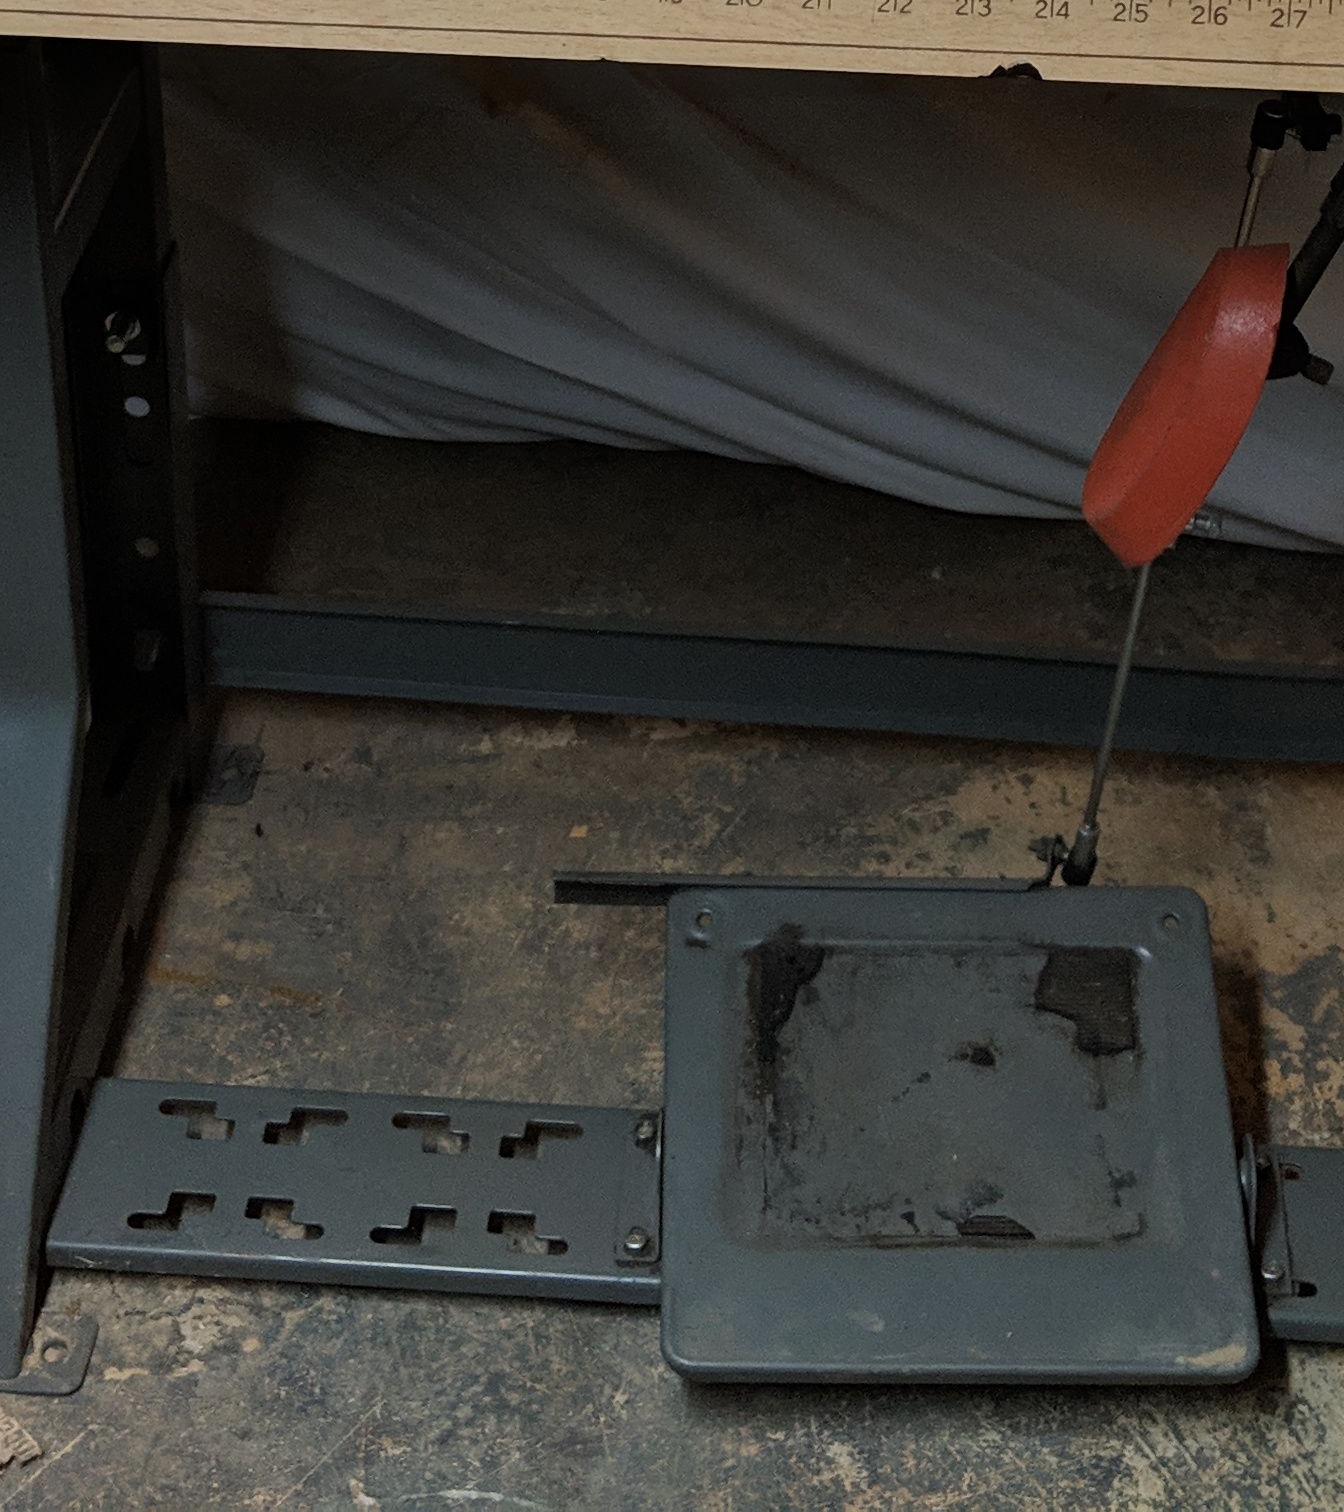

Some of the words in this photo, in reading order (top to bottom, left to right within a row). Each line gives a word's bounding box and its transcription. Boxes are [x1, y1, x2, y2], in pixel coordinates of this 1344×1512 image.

[1035, 0, 1071, 20] 24
[1114, 2, 1149, 24] 25
[1191, 4, 1228, 25] 26
[1270, 7, 1306, 29] 27
